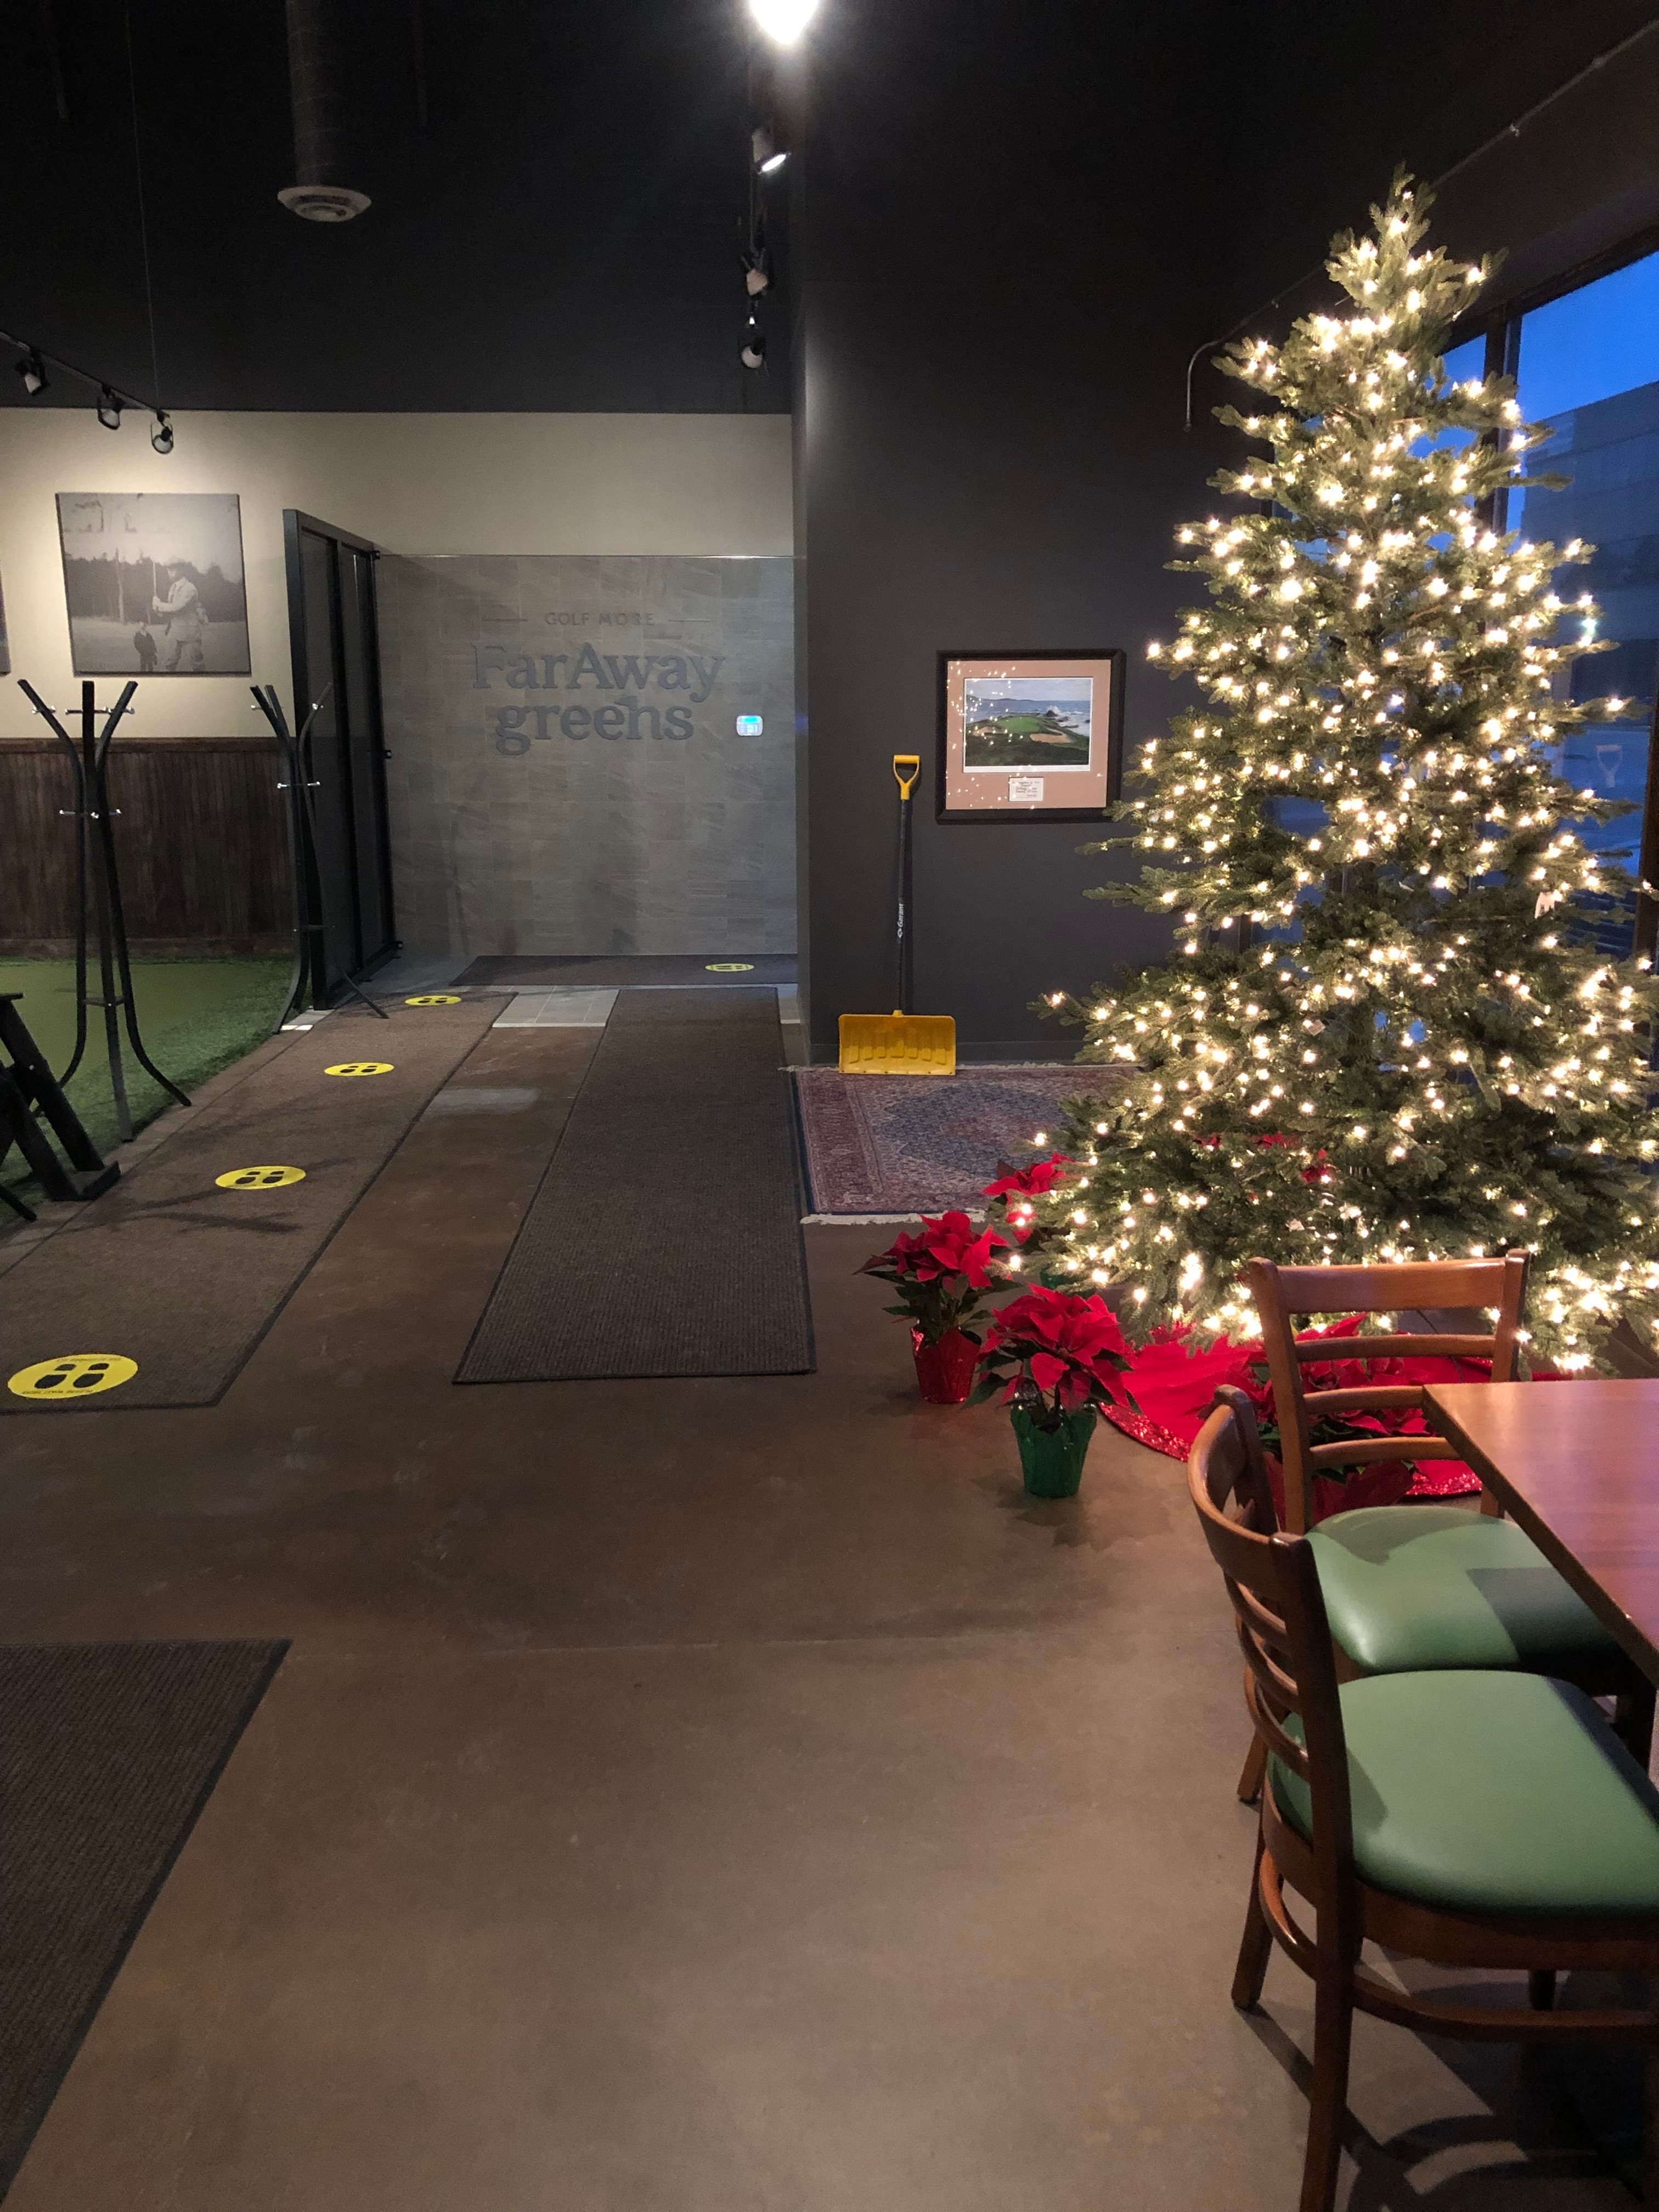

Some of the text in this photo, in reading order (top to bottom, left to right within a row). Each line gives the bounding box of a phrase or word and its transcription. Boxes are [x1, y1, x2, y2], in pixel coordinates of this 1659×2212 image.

[545, 612, 655, 626] GOLF MORE
[471, 641, 726, 703] FarAway
[495, 696, 695, 756] greens
